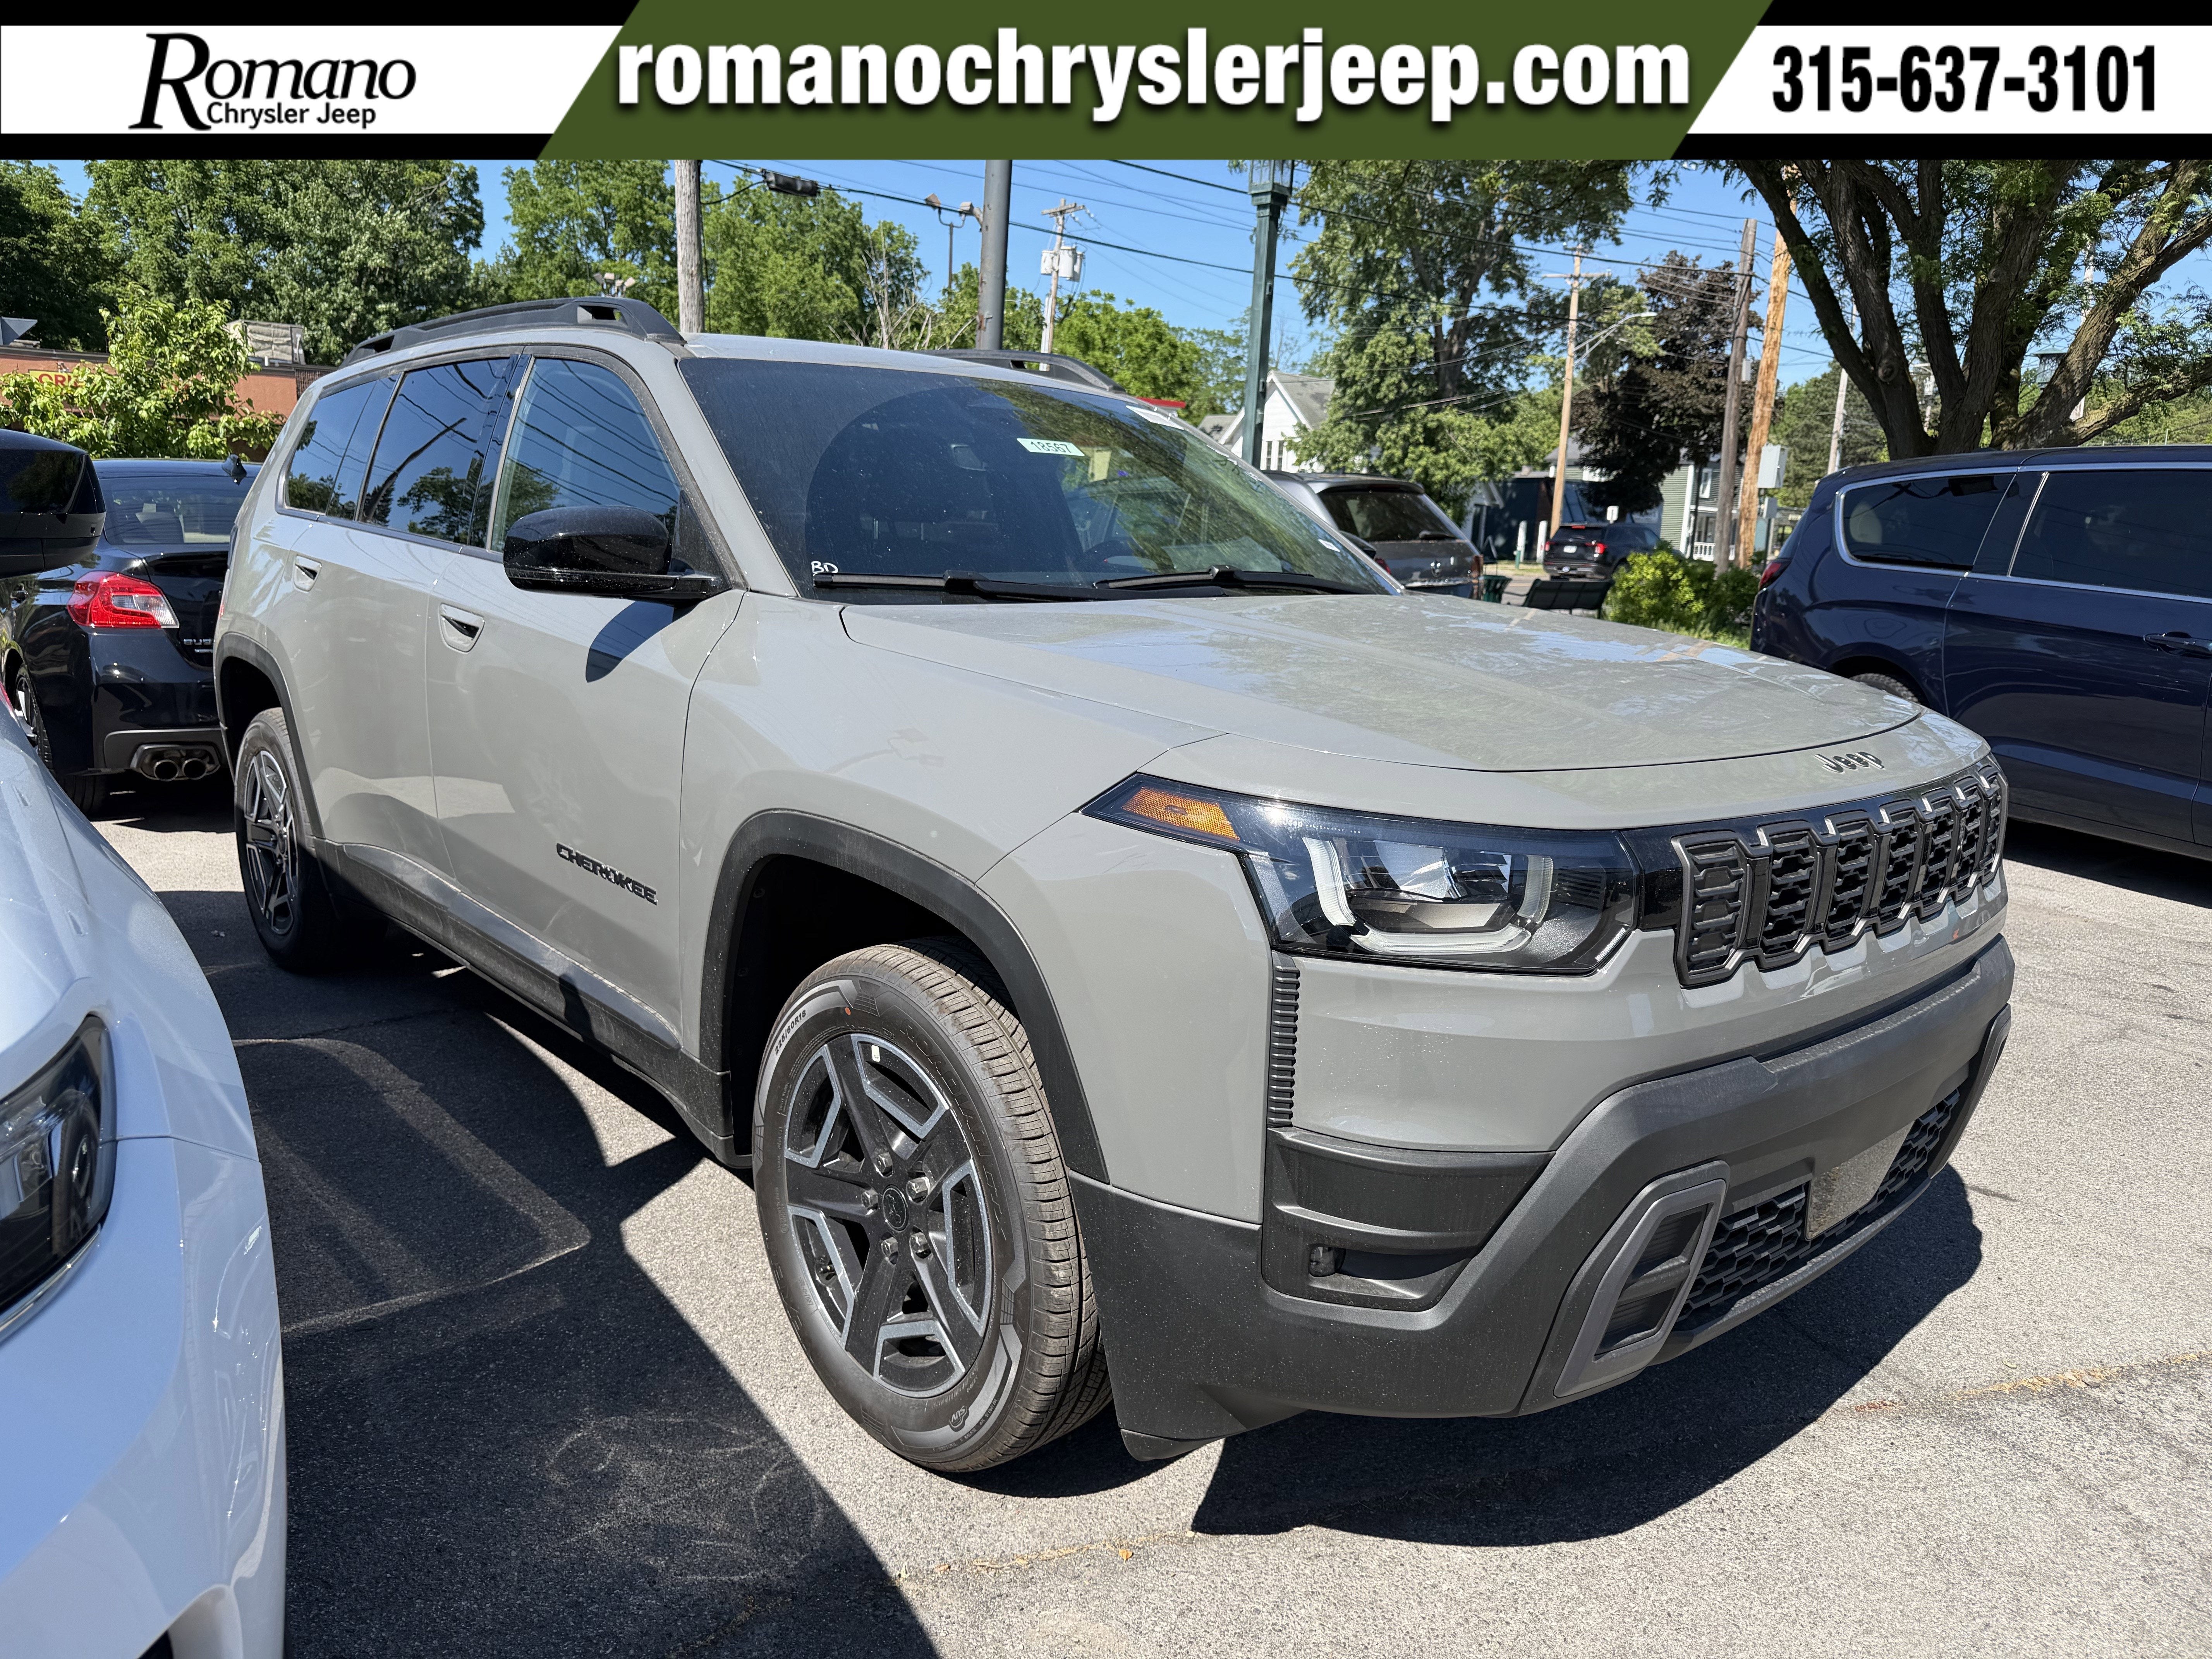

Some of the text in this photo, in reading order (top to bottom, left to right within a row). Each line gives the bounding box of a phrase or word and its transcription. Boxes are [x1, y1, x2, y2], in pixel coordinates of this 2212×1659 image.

[1030, 441, 1072, 453] 18567
[1814, 751, 1885, 773] Jeep
[556, 842, 658, 906] CHEROKEE
[775, 1009, 807, 1056] 225/60R18
[951, 1405, 968, 1423] SUV
